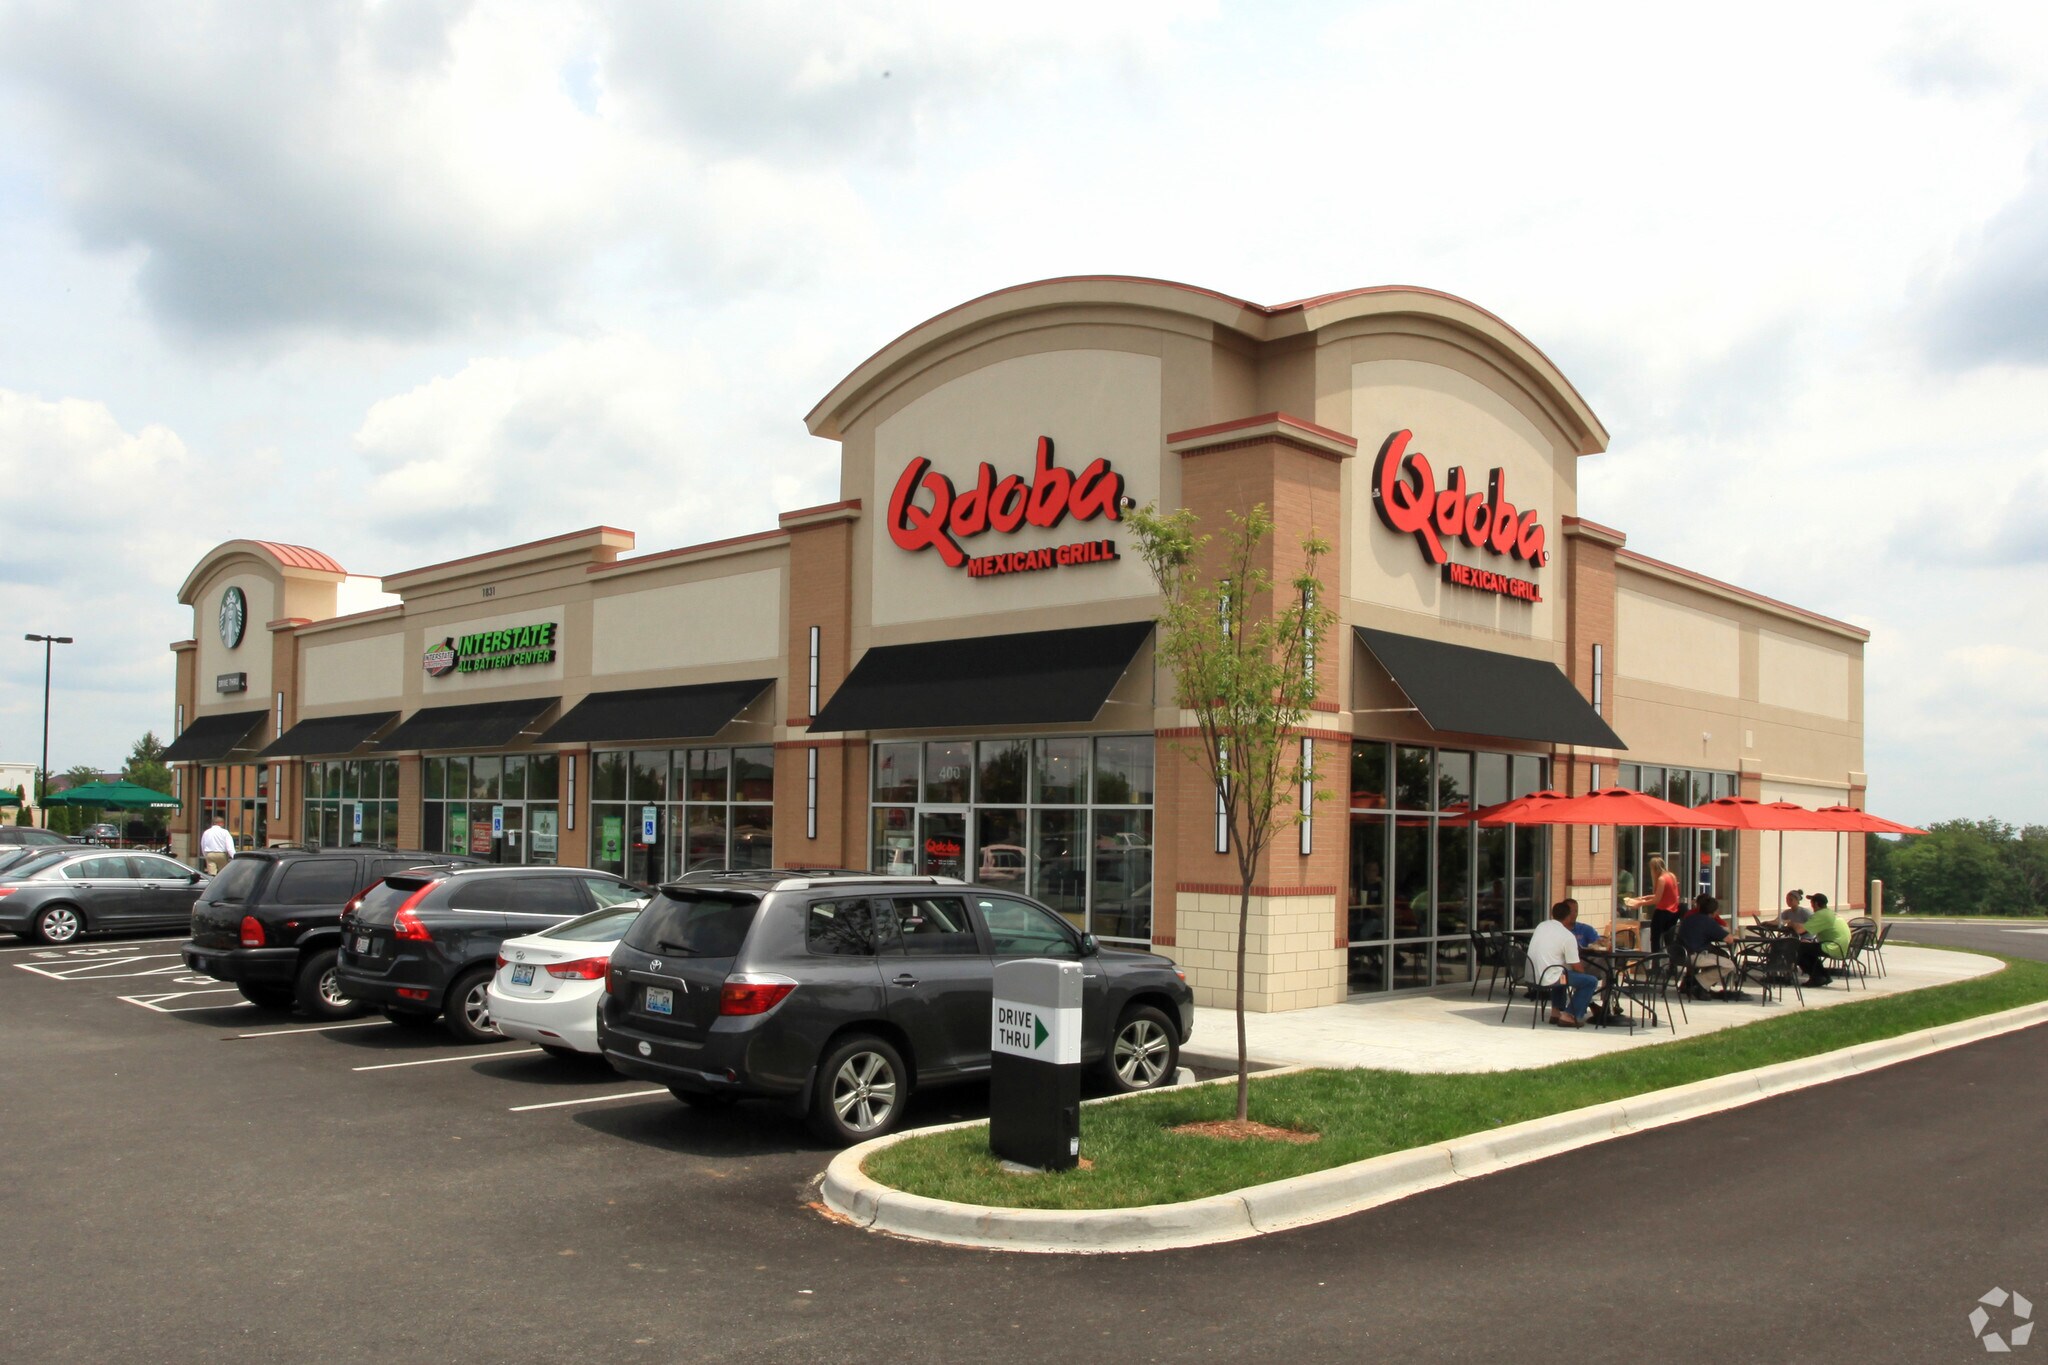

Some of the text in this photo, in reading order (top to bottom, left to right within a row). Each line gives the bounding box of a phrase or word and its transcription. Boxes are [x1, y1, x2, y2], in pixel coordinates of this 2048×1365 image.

[887, 435, 1126, 568] Qdoba
[1375, 429, 1546, 568] Qdoba
[967, 539, 1115, 577] MEXICAN GRILL
[482, 586, 496, 598] 1831
[1449, 562, 1543, 603] MEXICAN GRILL
[457, 622, 554, 656] INTERSTATE
[458, 660, 473, 673] ALL
[474, 653, 512, 671] BATTERY
[513, 650, 551, 666] CENTER
[939, 766, 960, 780] 400
[998, 1007, 1032, 1028] DRIVE
[999, 1028, 1030, 1049] THRU
